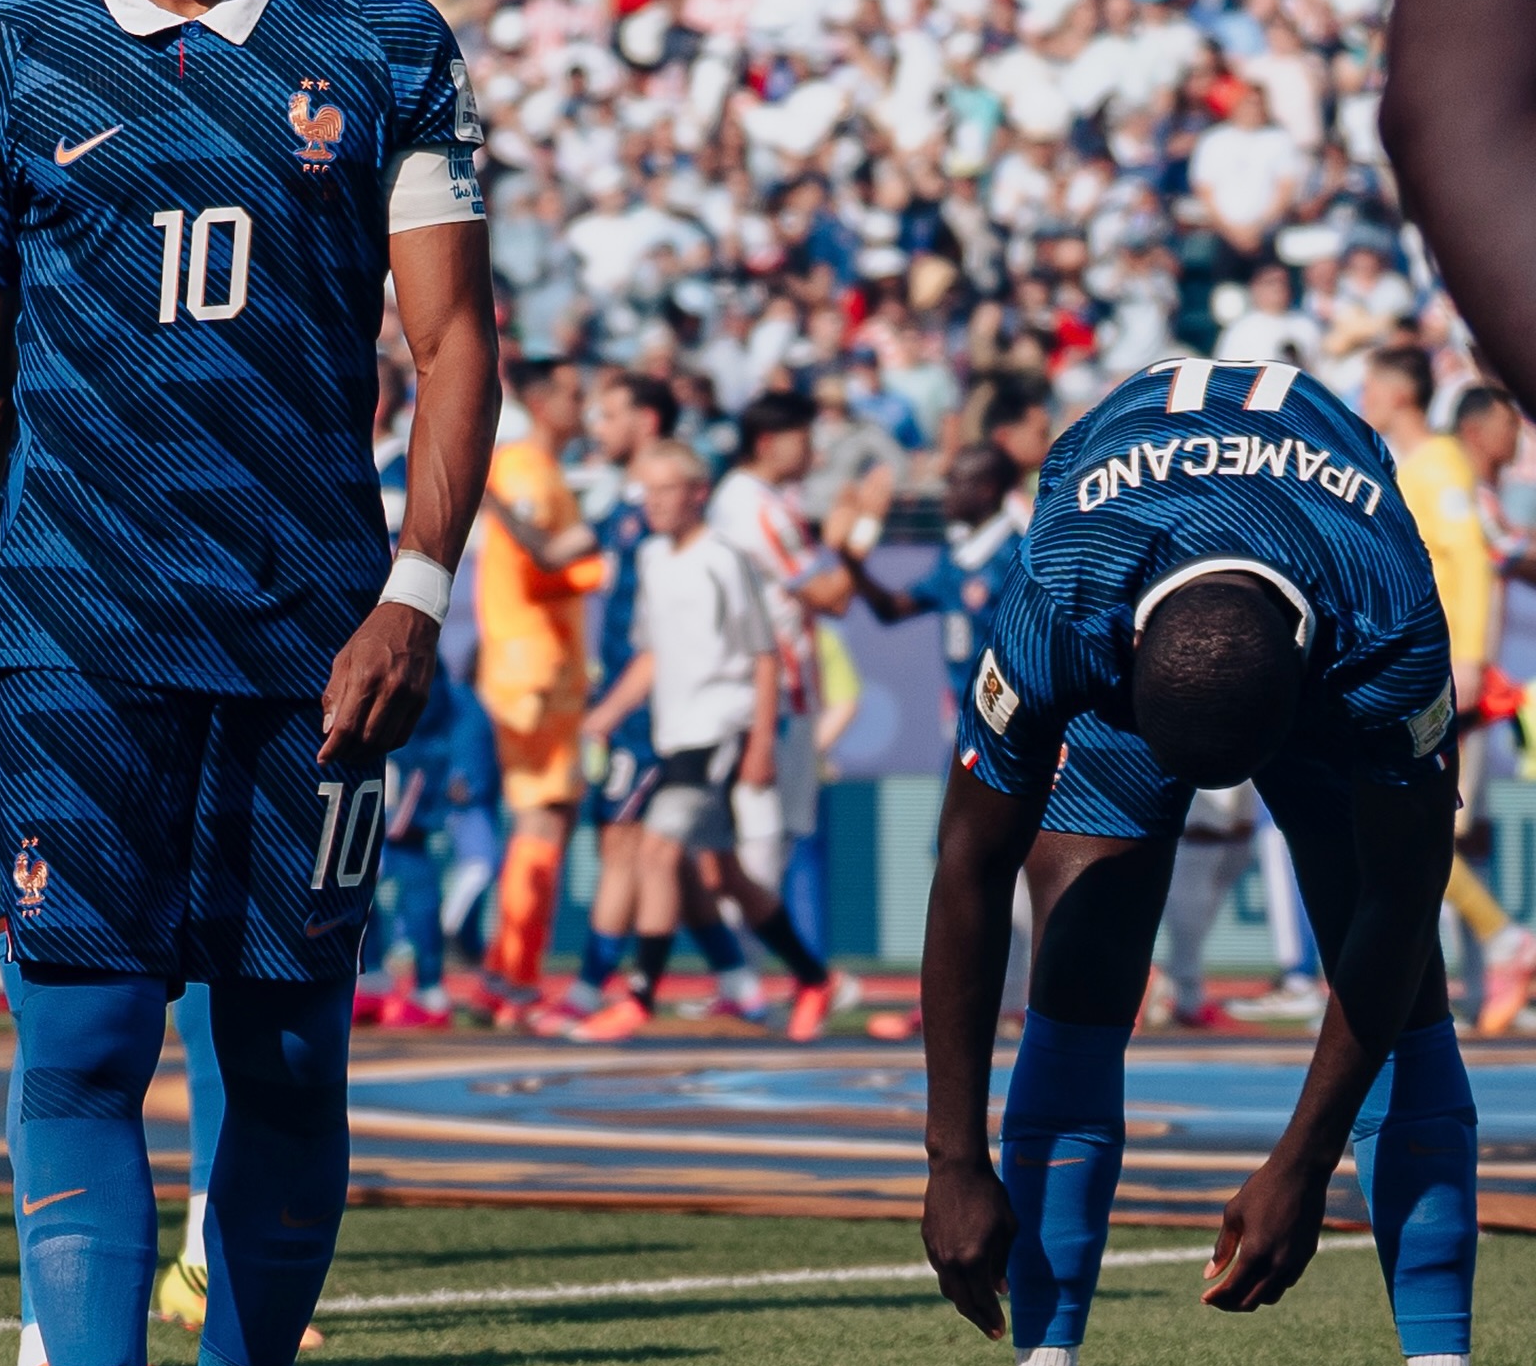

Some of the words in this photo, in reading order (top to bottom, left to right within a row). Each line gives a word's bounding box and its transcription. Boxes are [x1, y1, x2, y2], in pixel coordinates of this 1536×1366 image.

[153, 206, 252, 324] 10
[1077, 436, 1382, 516] UPAMECANO
[310, 779, 383, 890] 10
